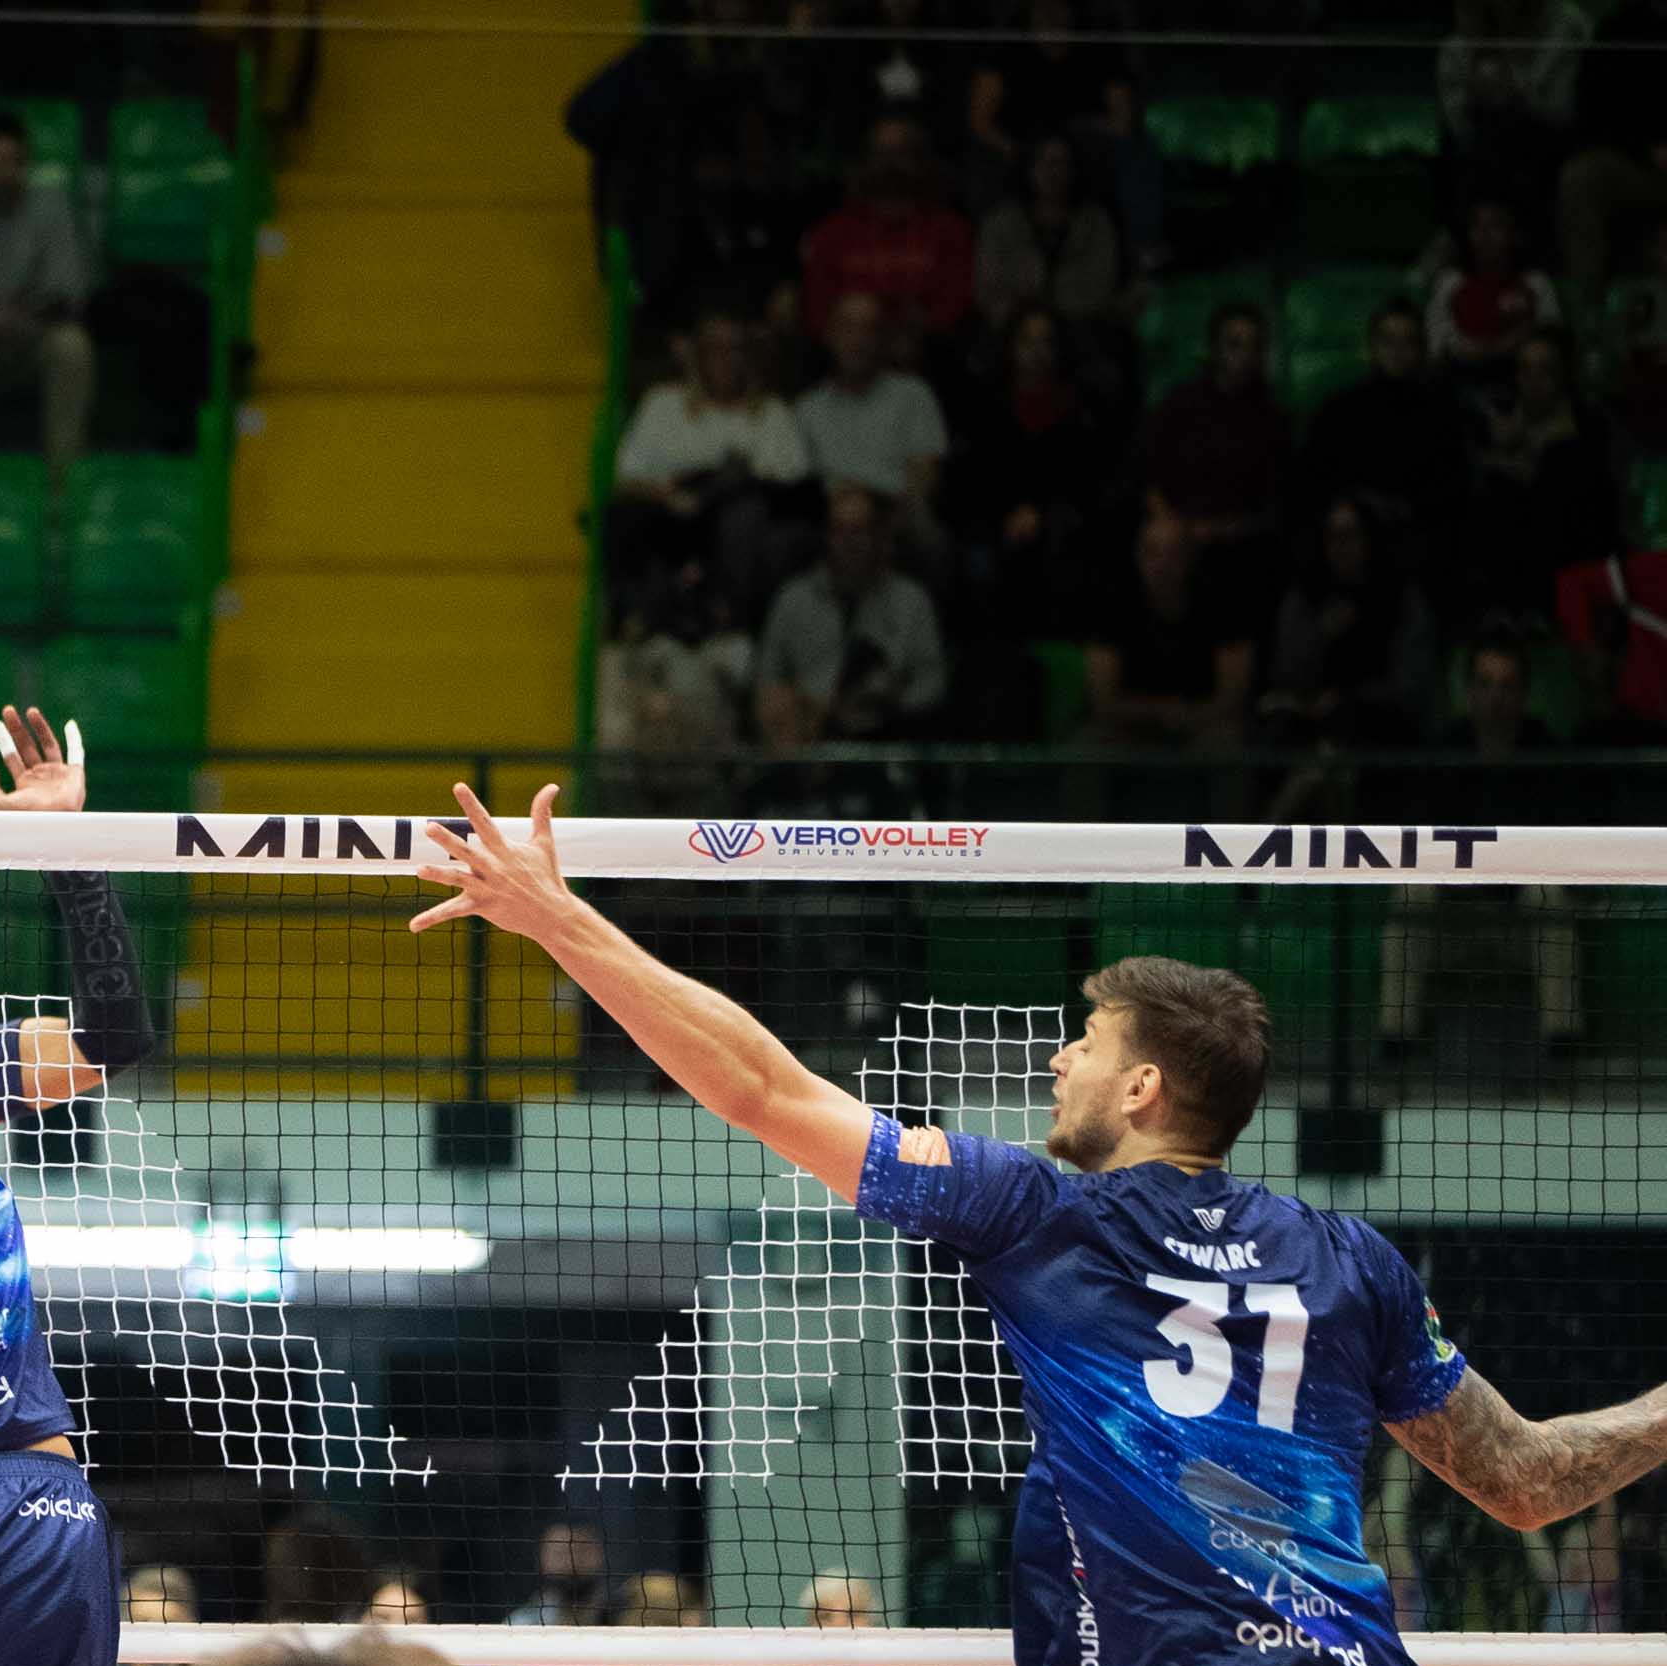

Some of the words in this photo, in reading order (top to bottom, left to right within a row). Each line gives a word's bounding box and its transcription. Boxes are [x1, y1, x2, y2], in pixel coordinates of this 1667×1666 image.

[771, 826, 990, 847] VEROVOLLEY
[1184, 825, 1497, 869] MINT
[778, 848, 854, 857] DRIVEN
[868, 848, 889, 857] BY
[903, 848, 982, 858] VALUES
[1143, 1273, 1310, 1434] 31
